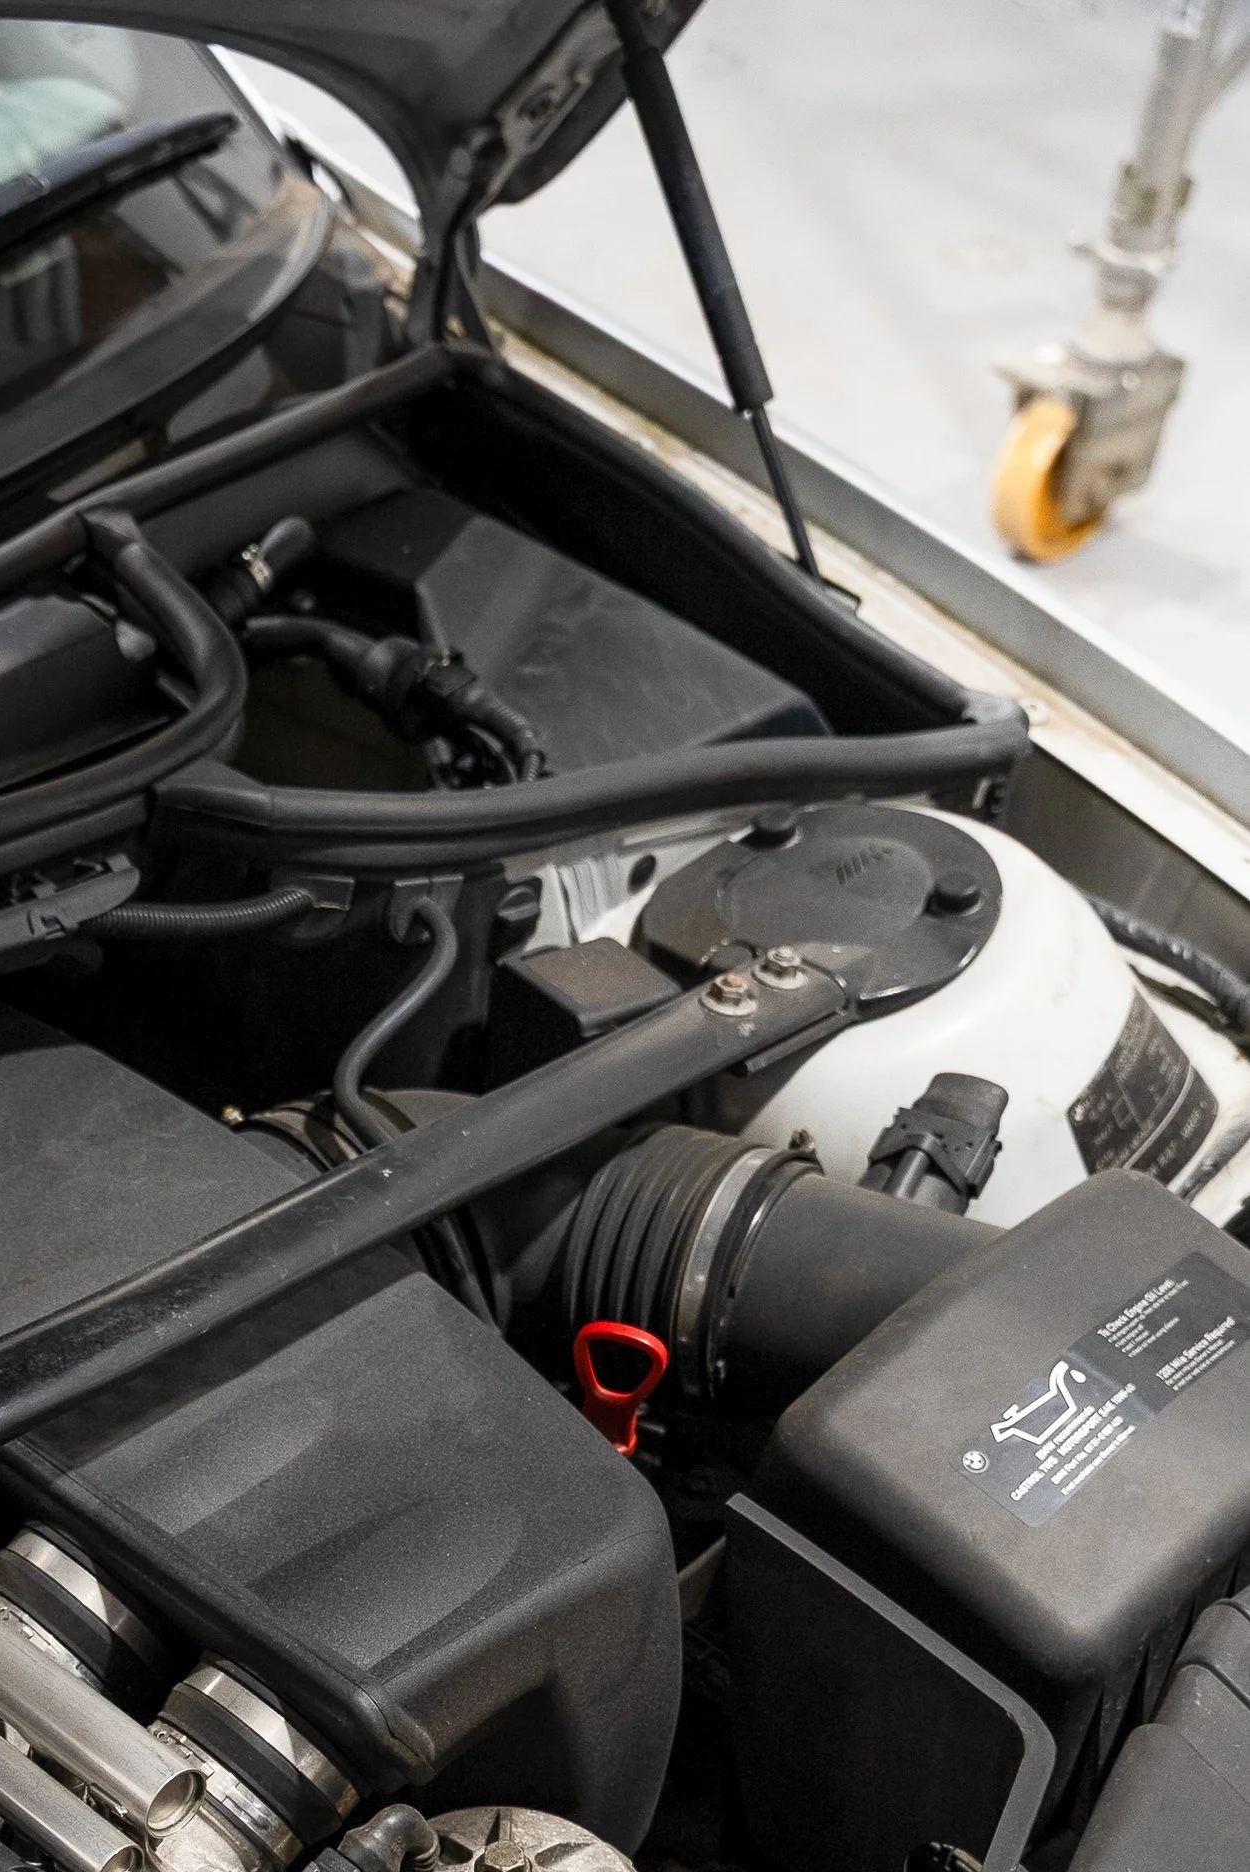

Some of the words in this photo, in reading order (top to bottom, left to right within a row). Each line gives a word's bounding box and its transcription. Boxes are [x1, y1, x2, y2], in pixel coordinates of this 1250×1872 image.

[1105, 1314, 1129, 1332] Check
[1123, 1298, 1149, 1318] Engine
[1155, 1364, 1176, 1380] 1200
[1169, 1355, 1188, 1369] Mile
[1182, 1339, 1209, 1359] Service
[1010, 1470, 1046, 1501] CASTROL
